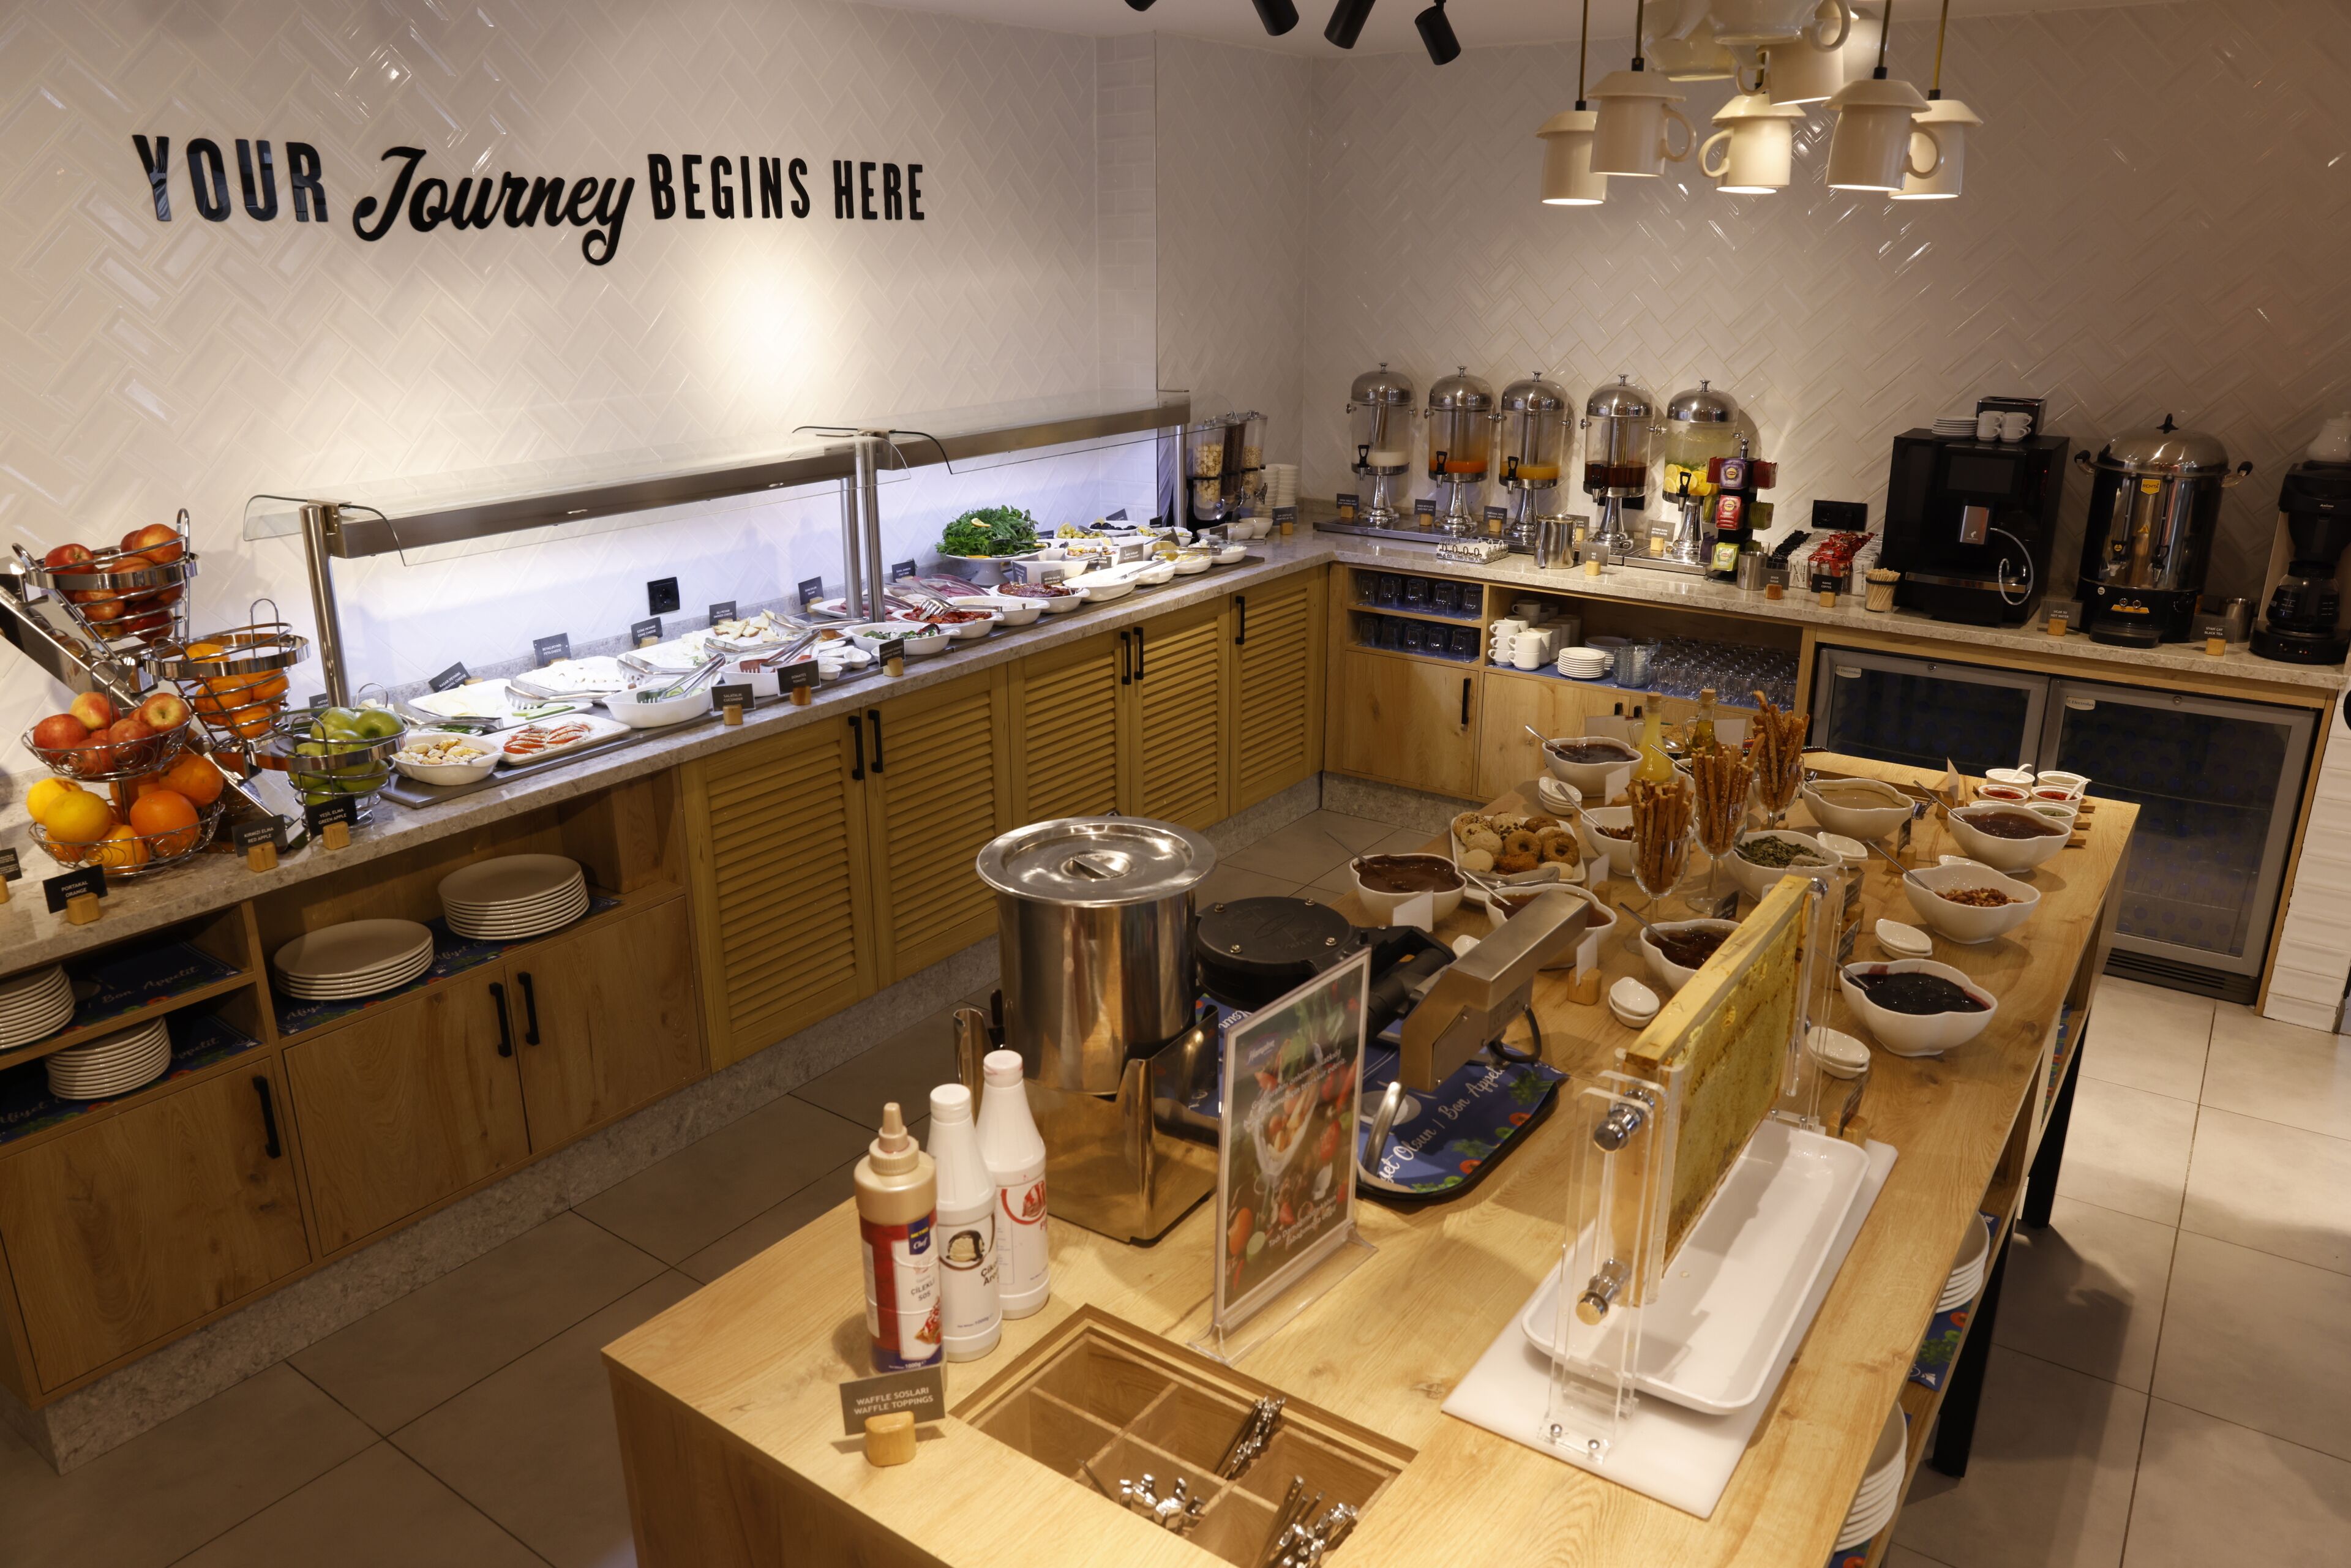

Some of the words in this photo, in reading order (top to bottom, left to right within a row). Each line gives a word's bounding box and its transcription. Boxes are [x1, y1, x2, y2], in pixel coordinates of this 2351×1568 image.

[131, 134, 329, 222] YOUR
[352, 146, 635, 266] Journey
[648, 153, 811, 220] BEGINS
[833, 159, 925, 221] HERE
[455, 674, 467, 683] CHEESE
[61, 881, 89, 891] PORTAKAL
[66, 888, 88, 898] ORANGE
[101, 989, 136, 1003] Bon
[1393, 1128, 1437, 1161] Olsun
[1438, 1097, 1470, 1120] Bon
[913, 1236, 928, 1250] Chef
[918, 1290, 931, 1301] SOS
[856, 1392, 893, 1406] WAFFLE
[894, 1387, 929, 1399] SOSLARI
[853, 1403, 890, 1415] WAFFLE
[891, 1395, 934, 1408] TOPPINGS
